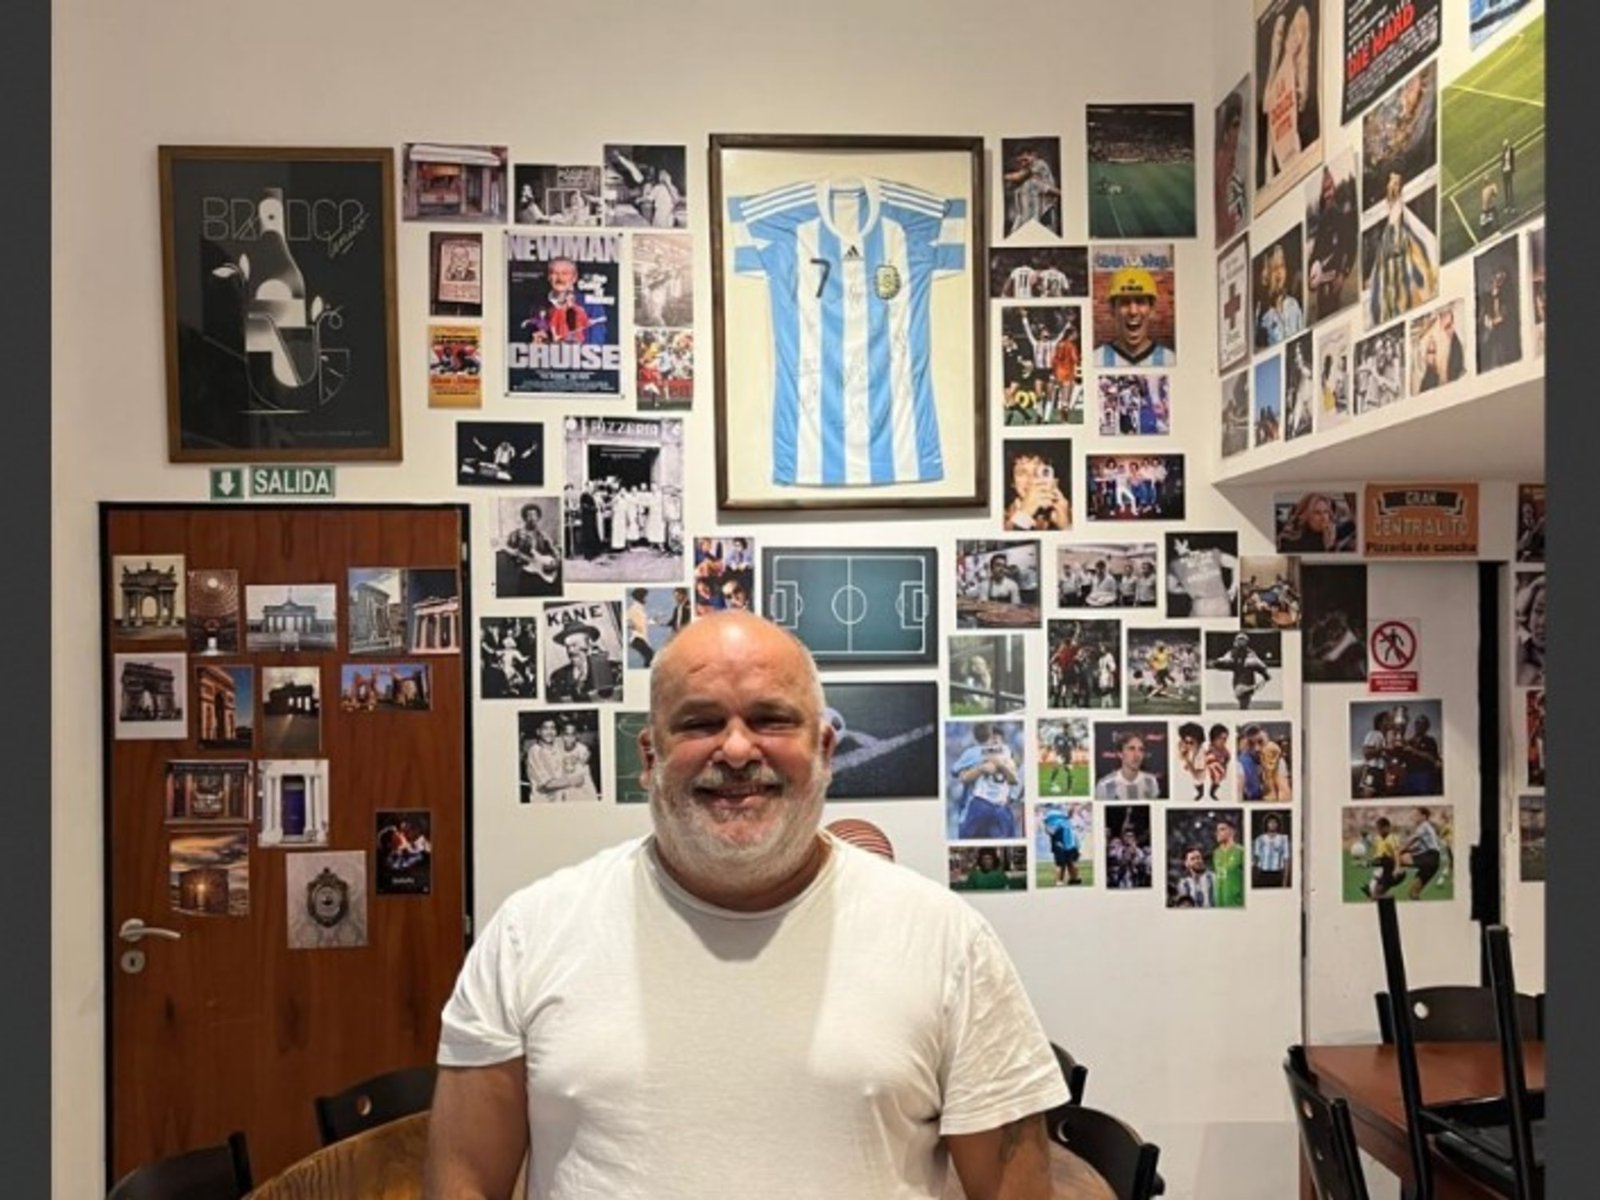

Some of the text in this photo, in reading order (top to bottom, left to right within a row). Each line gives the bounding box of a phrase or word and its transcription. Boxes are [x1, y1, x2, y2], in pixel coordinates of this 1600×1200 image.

[508, 235, 619, 262] NEWMAN
[810, 257, 831, 298] 7
[509, 343, 620, 370] CRUISE
[255, 469, 330, 493] SALIDA
[547, 605, 602, 627] KANE
